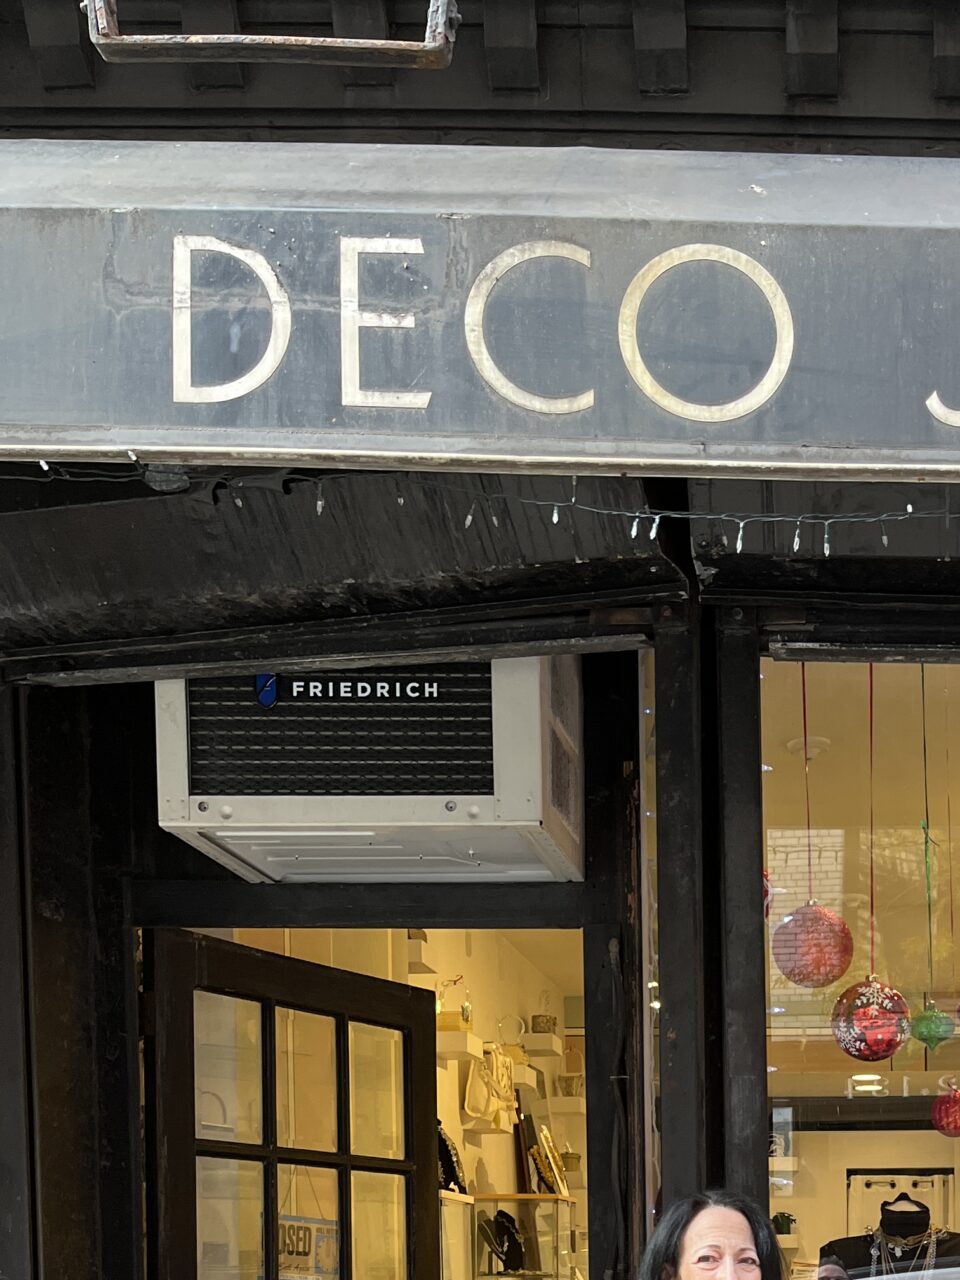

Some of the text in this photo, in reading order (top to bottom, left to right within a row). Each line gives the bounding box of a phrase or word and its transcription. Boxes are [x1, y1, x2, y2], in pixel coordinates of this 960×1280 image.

[172, 234, 795, 423] DECO
[292, 681, 439, 698] FRIEDRICH
[279, 1224, 312, 1257] OSED
